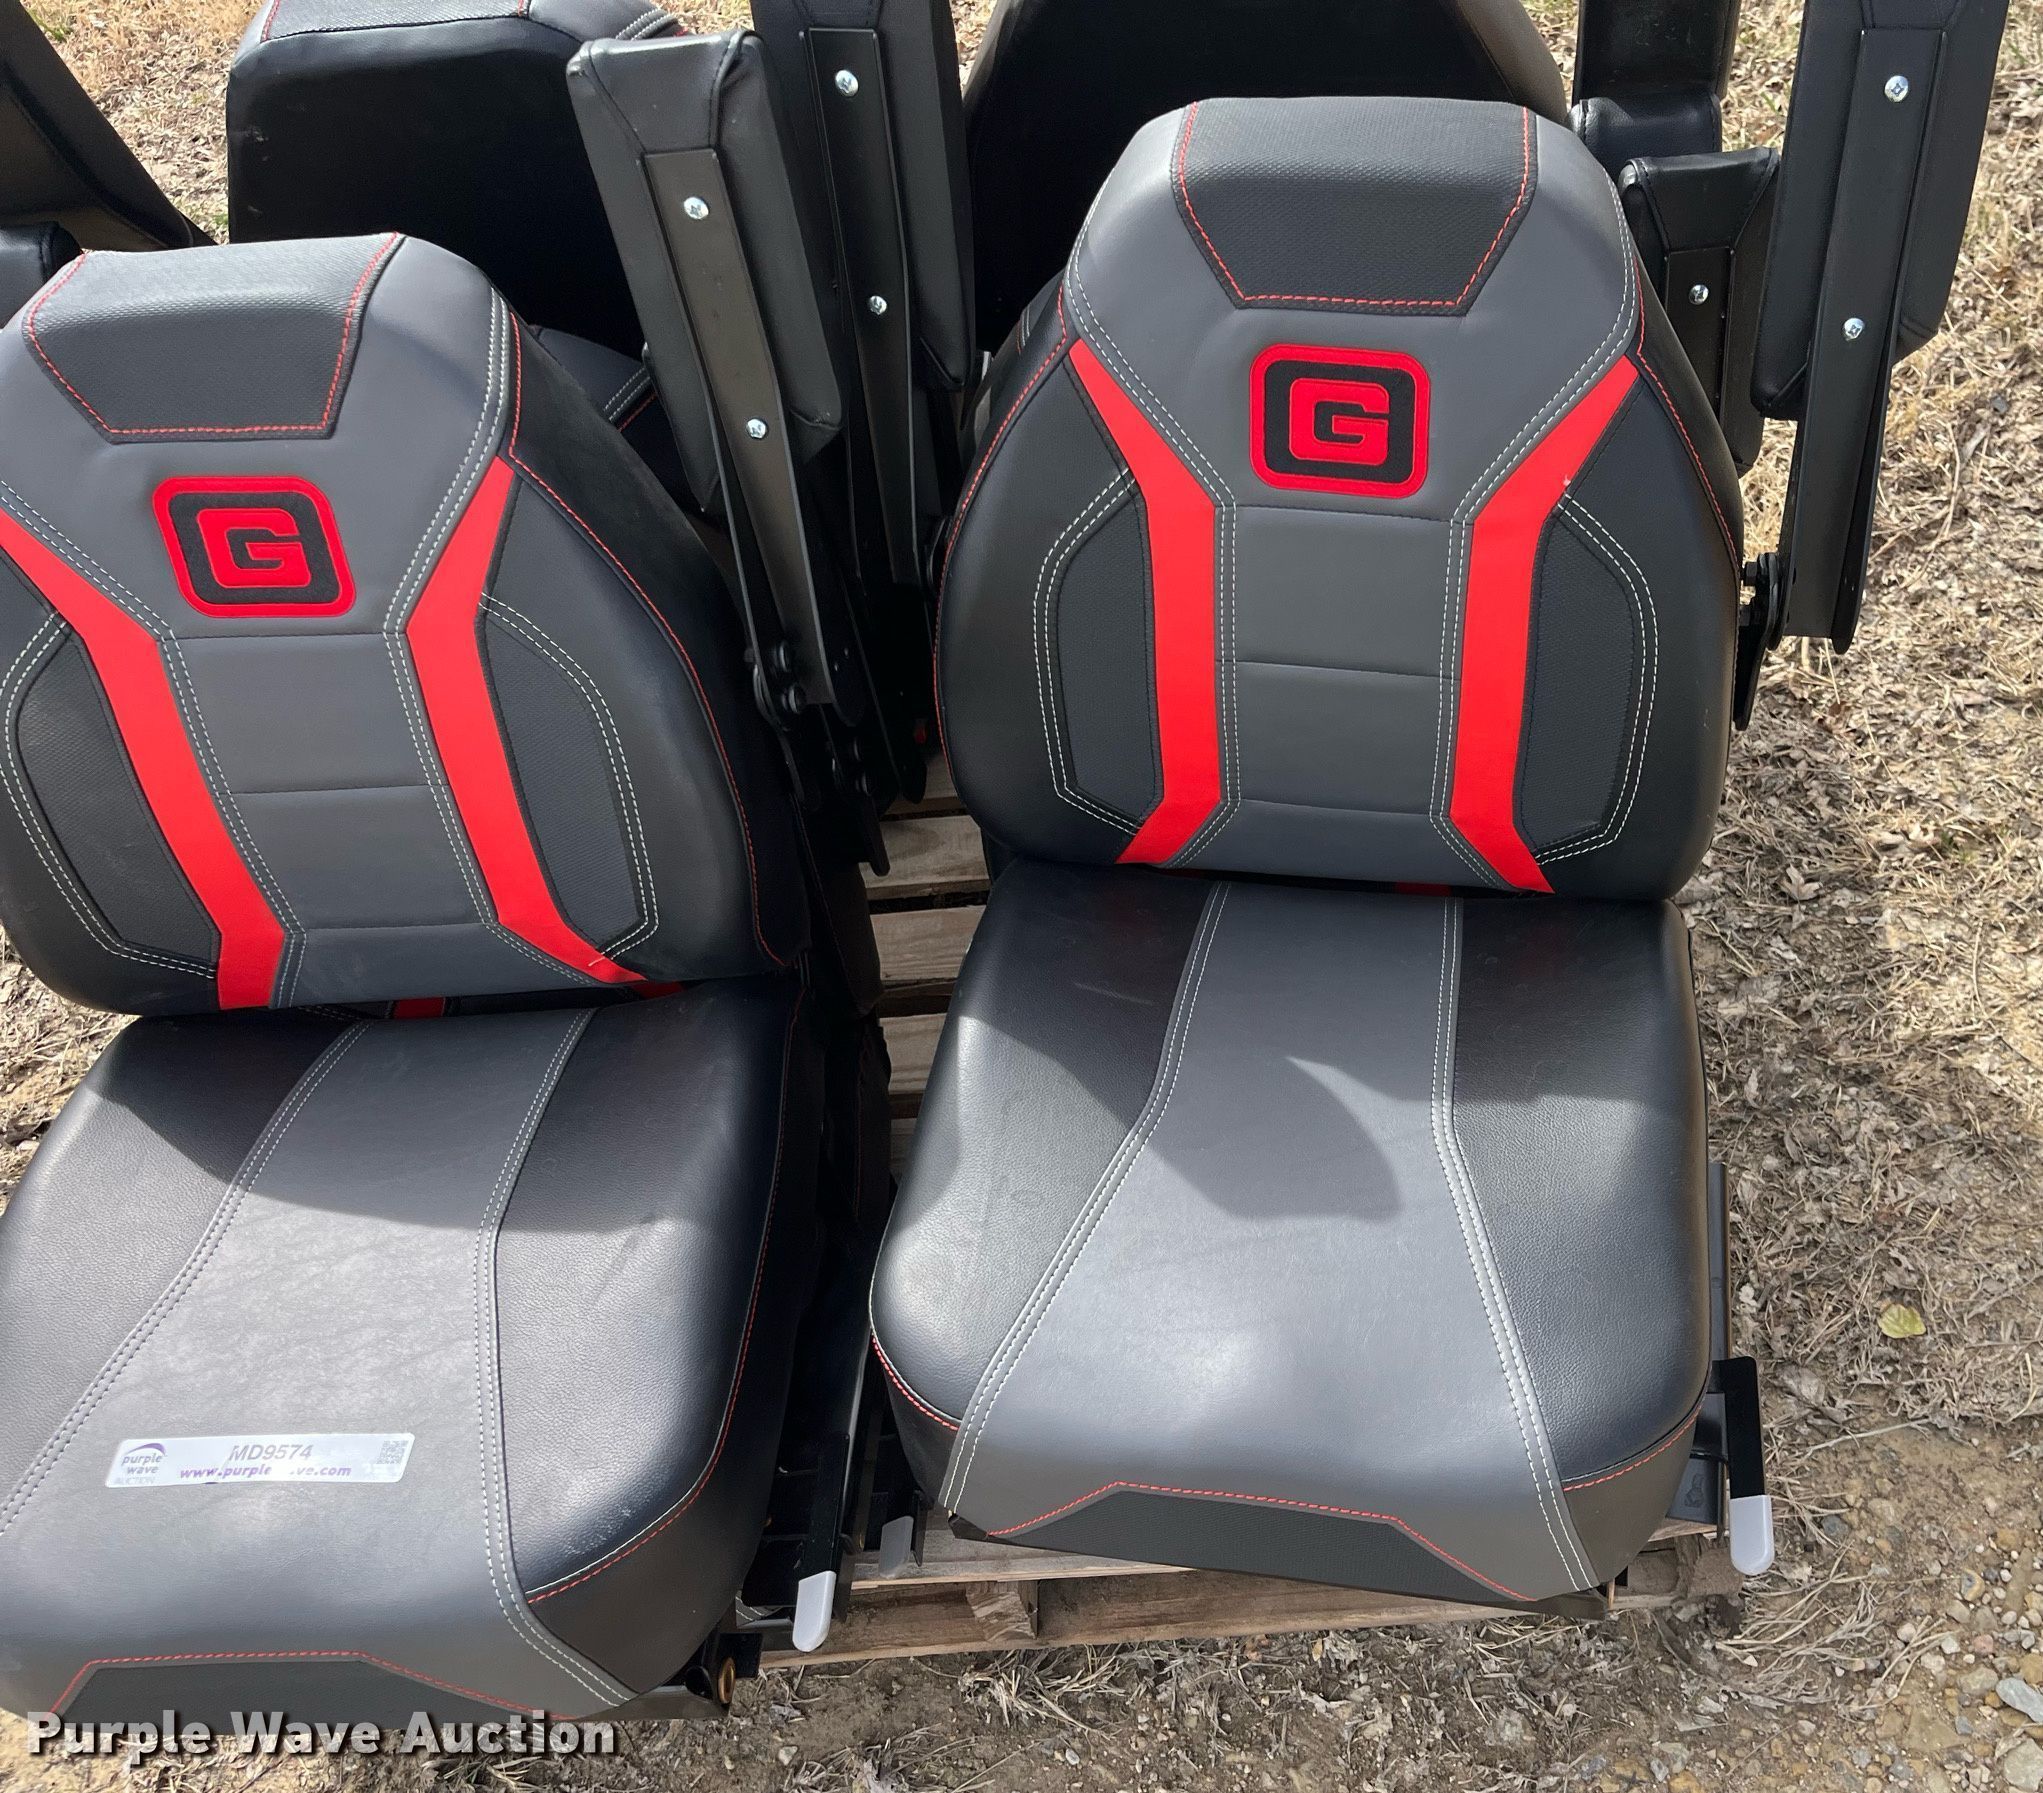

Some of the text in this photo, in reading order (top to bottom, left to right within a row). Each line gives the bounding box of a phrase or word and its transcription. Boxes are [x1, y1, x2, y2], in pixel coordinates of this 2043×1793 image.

[1289, 377, 1390, 466] G
[196, 507, 312, 589] G
[121, 1453, 163, 1467] purple
[228, 1444, 314, 1461] MD9574
[127, 1466, 160, 1475] wave
[180, 1464, 352, 1479] www.purpleve.com
